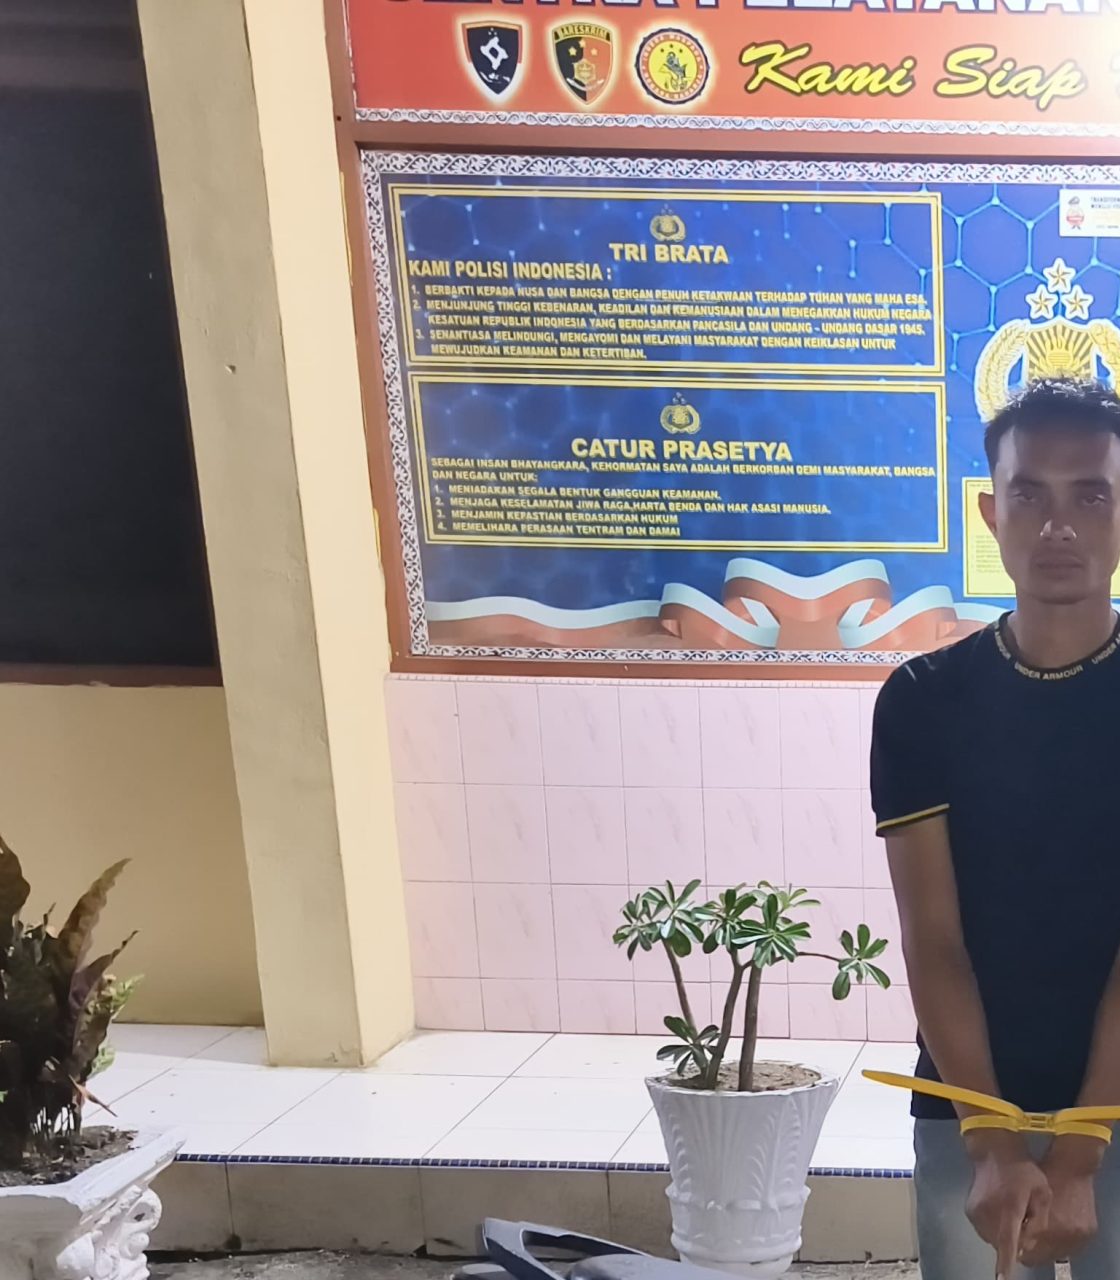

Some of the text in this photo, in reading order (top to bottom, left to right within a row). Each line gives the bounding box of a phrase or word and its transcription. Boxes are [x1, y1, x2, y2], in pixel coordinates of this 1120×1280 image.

[740, 40, 916, 96] Kami
[935, 45, 1086, 110] Siap
[609, 243, 729, 264] TRI BRATA
[409, 260, 450, 277] KAMI
[456, 261, 508, 278] POLISI
[513, 262, 603, 280] INDONESIA
[431, 345, 500, 355] MEWUJUDKAN
[504, 346, 557, 356] KEAMANAN
[560, 347, 580, 357] DAN
[571, 438, 793, 462] CATUR PRASETYA
[431, 458, 475, 467] SEBAGAI
[477, 459, 508, 468] INSAN
[592, 461, 660, 472] KEHORMATAN
[663, 463, 688, 473] SAYA
[691, 463, 730, 473] ADALAH
[733, 464, 794, 475] BERKORBAN
[796, 465, 821, 475] DEMI
[894, 467, 935, 477] BANGSA
[433, 471, 452, 479] DAN
[456, 472, 496, 481] NEGARA
[1043, 665, 1083, 680] ARMOUR
